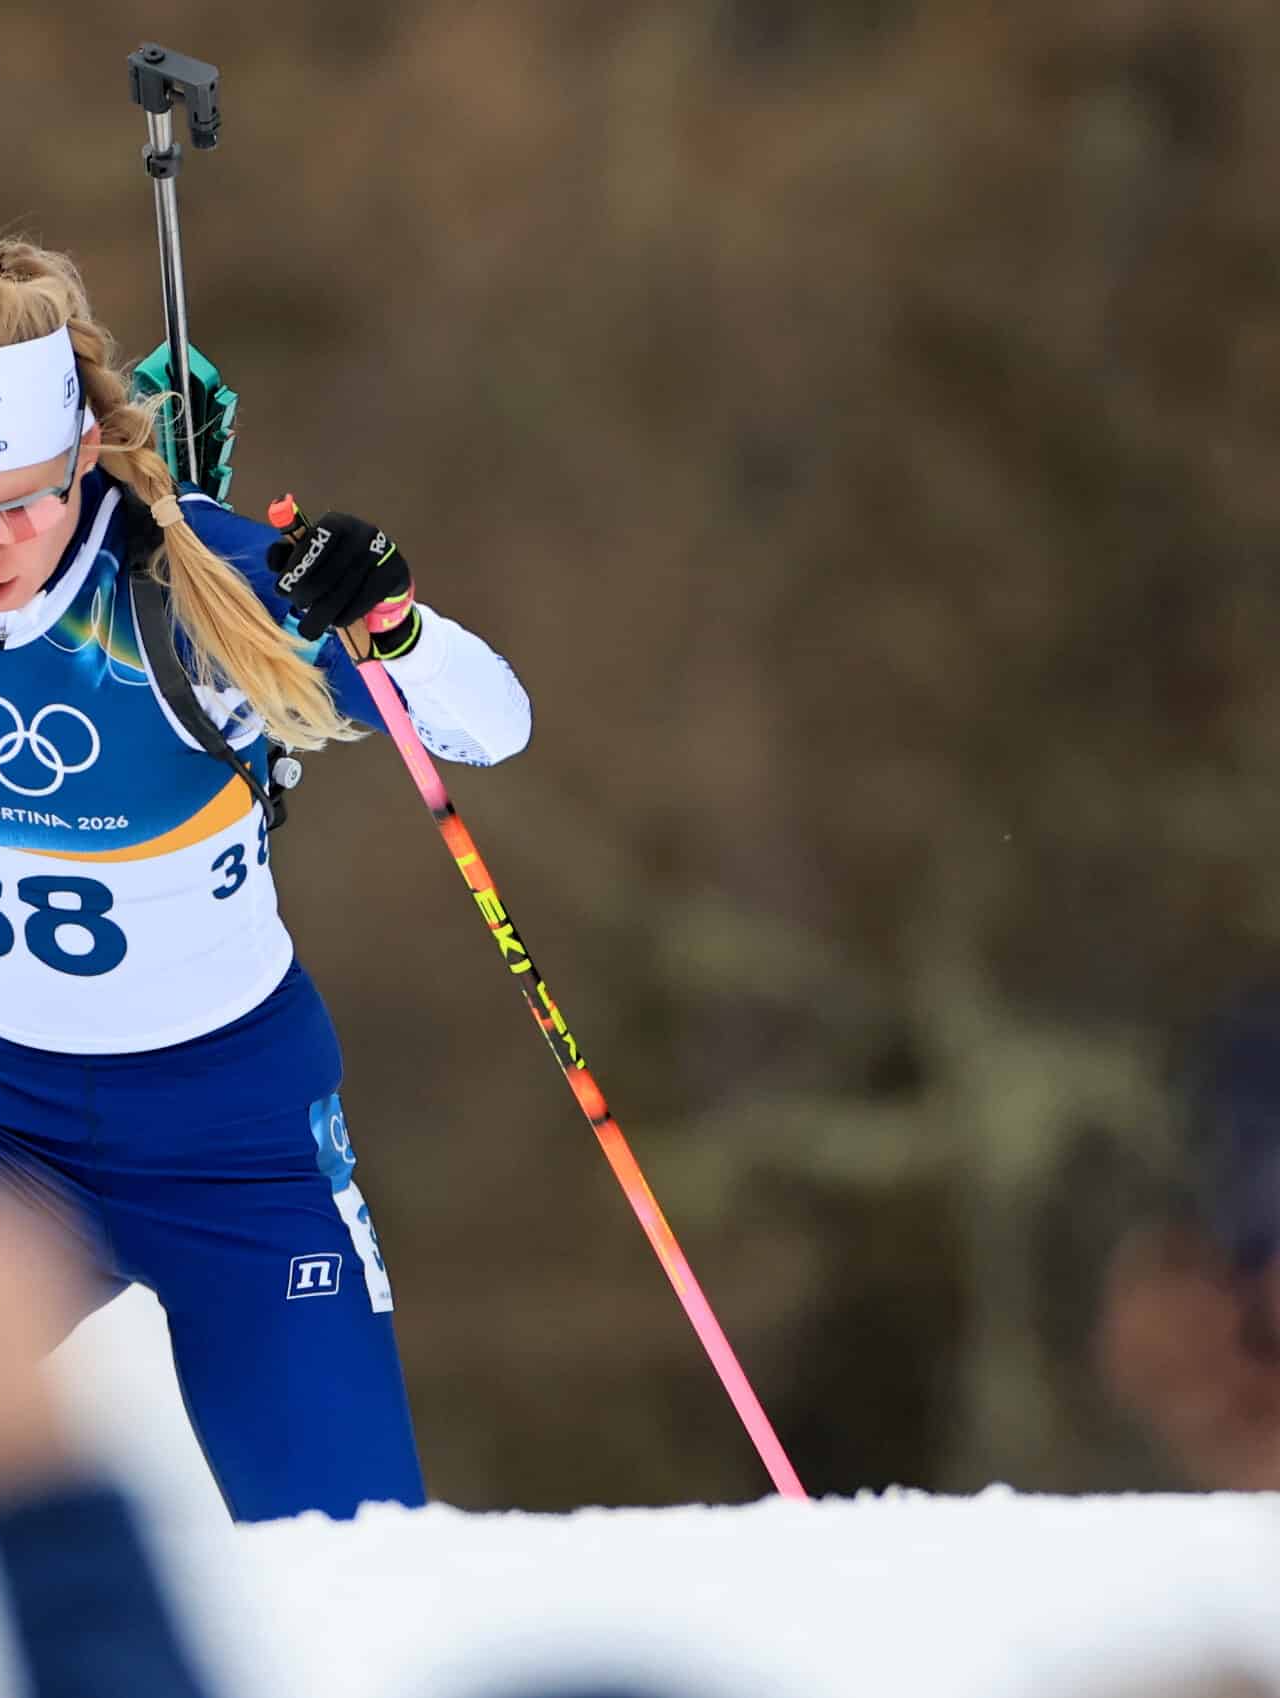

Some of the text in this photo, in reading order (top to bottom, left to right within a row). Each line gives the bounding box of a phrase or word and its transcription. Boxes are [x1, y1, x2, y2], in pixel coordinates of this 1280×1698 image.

[278, 527, 332, 592] Roeckl
[77, 815, 129, 830] 2026
[456, 852, 532, 974] LEKI
